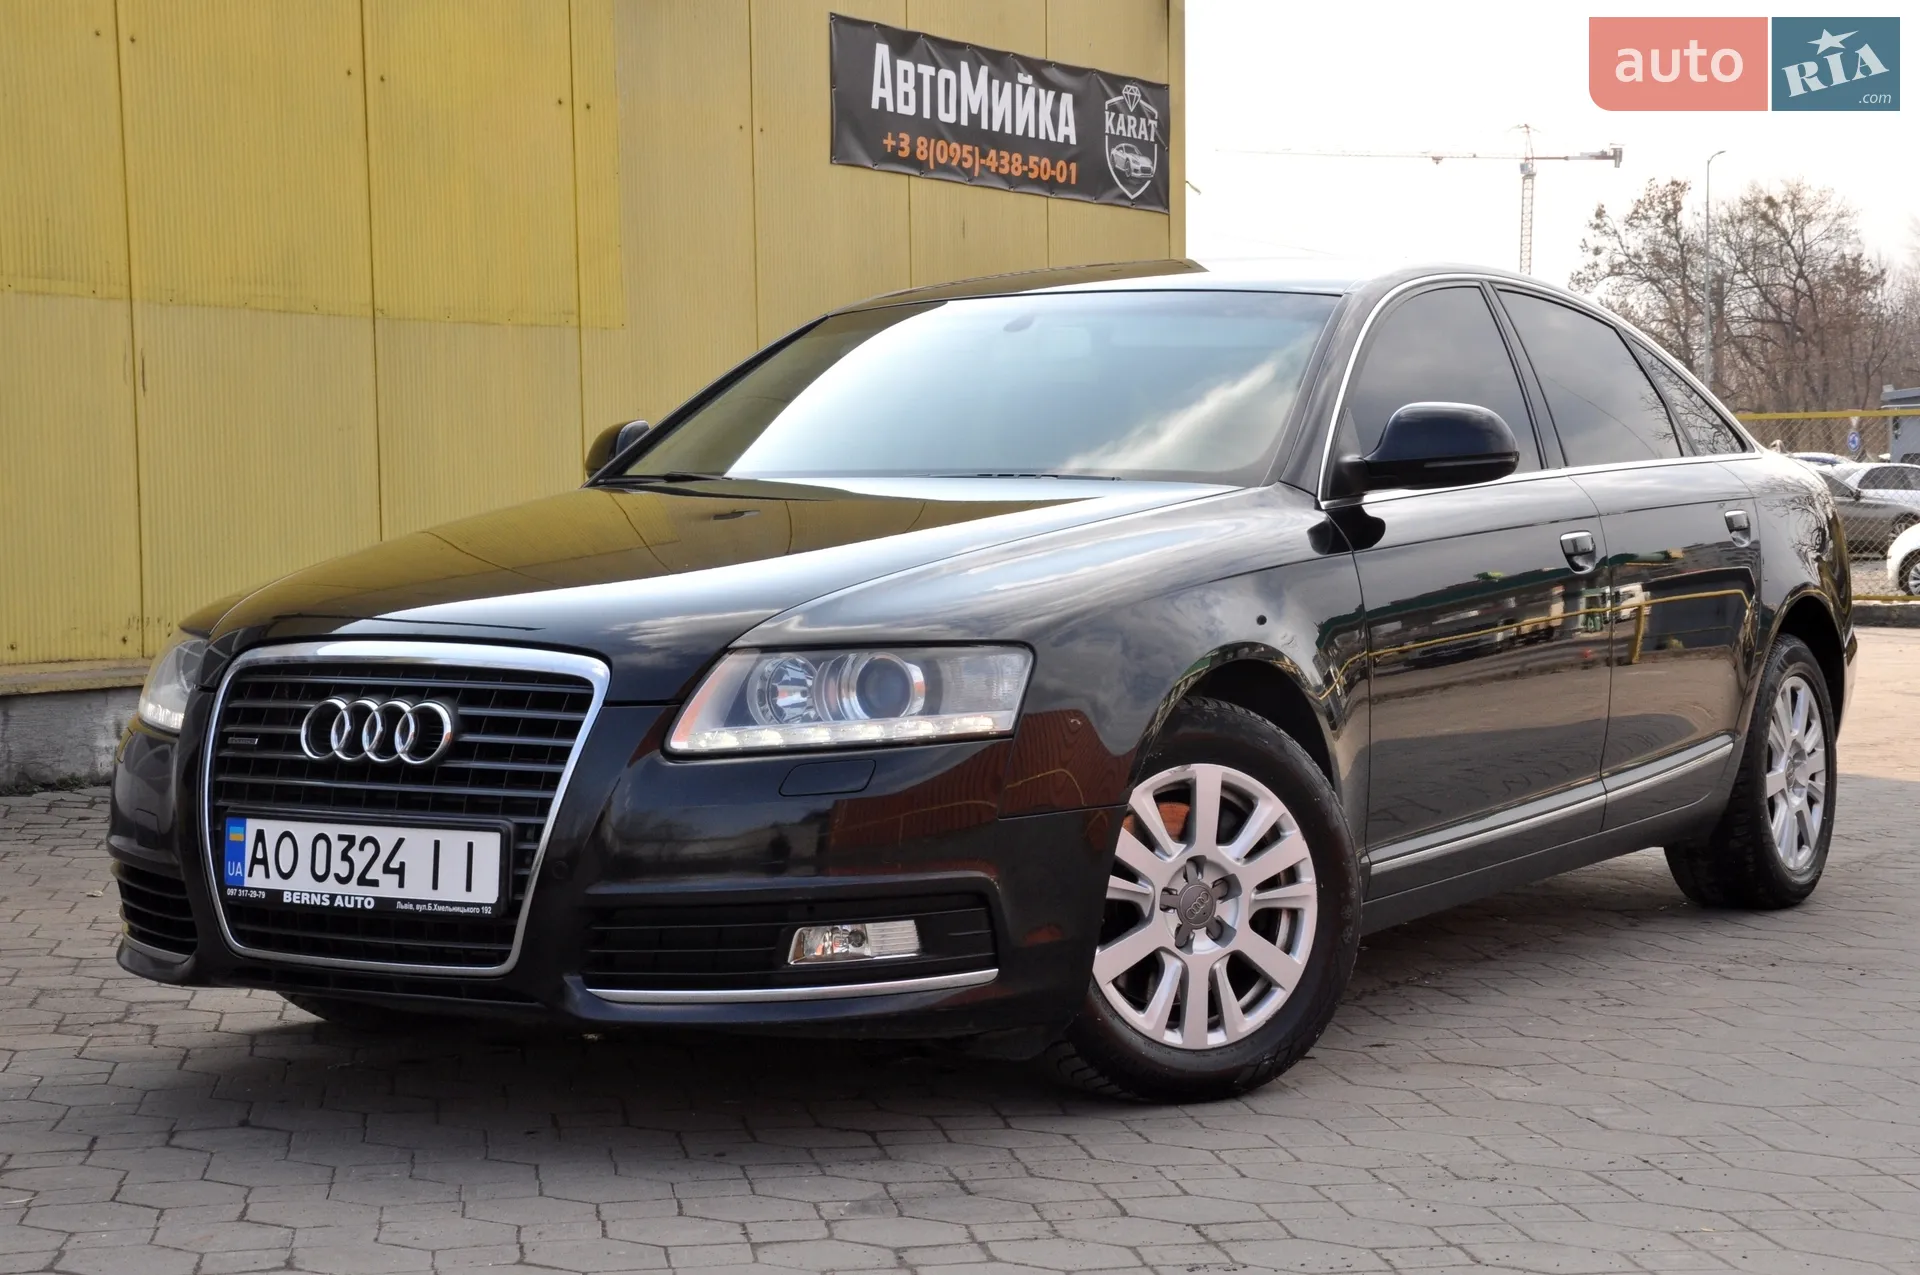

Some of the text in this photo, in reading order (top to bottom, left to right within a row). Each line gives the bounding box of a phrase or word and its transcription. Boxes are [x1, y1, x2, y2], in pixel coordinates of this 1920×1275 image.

[1105, 110, 1158, 143] KARAT
[247, 828, 299, 880] AO
[310, 832, 406, 889] 0324
[228, 861, 243, 877] UA
[226, 887, 266, 899] 097 317-29-79
[283, 890, 375, 910] BERNS AUTO
[481, 906, 492, 915] 192
